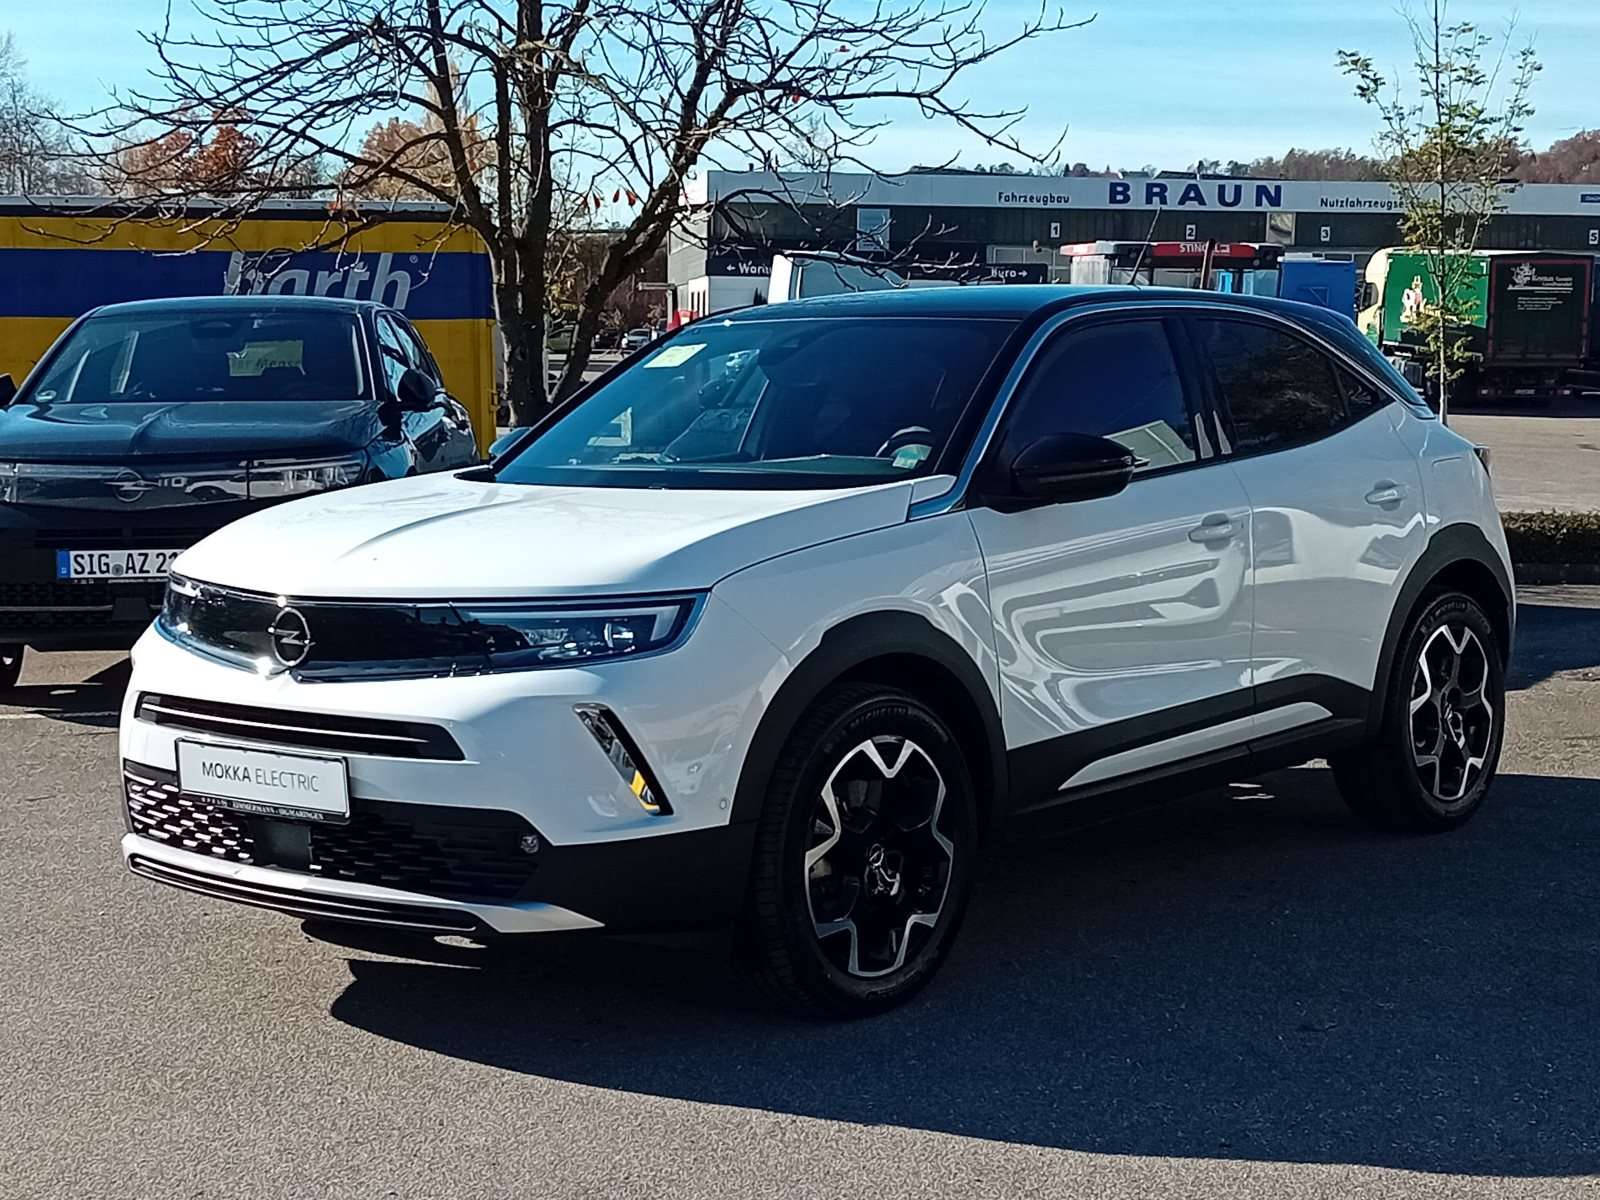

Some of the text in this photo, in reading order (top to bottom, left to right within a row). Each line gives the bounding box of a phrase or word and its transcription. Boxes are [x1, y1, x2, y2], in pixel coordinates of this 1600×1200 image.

[997, 191, 1070, 205] Fahrzeugbau
[1108, 181, 1282, 208] BRAUN
[73, 553, 110, 575] SIG
[125, 552, 151, 574] AZ
[202, 761, 320, 793] MOKKA ELECTRIC
